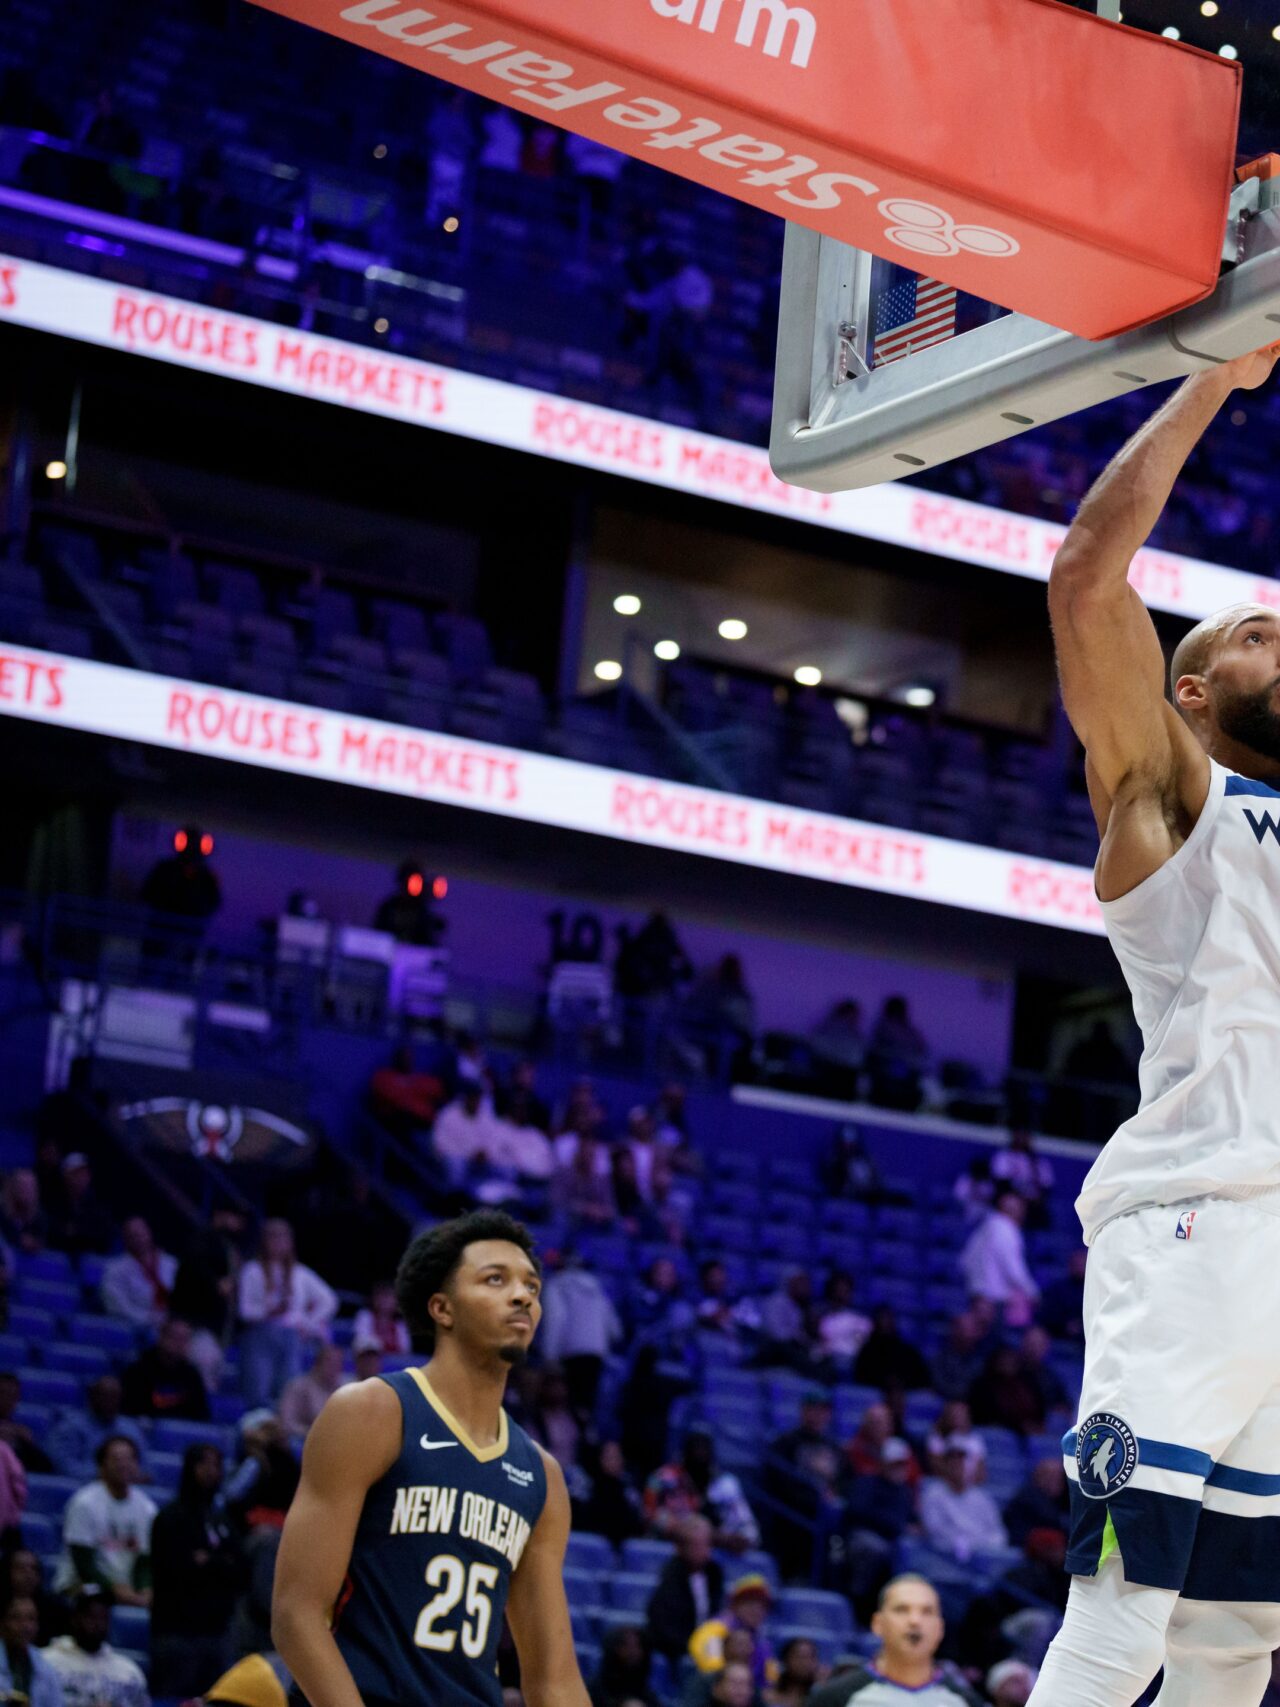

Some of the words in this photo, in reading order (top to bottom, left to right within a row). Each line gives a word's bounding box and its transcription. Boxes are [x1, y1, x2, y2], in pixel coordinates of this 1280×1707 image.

[113, 296, 259, 367] ROUSES
[275, 339, 445, 413] MARKETS
[534, 402, 664, 468] ROUSES
[168, 690, 320, 760] ROUSES
[340, 729, 518, 798] MARKETS
[613, 782, 748, 845] ROUSES
[766, 819, 923, 882] MARKETS
[1105, 1415, 1136, 1487] TIMBERWOLVES
[389, 1486, 459, 1535] NEW
[458, 1490, 532, 1573] ORLEAN
[413, 1553, 500, 1659] 25
